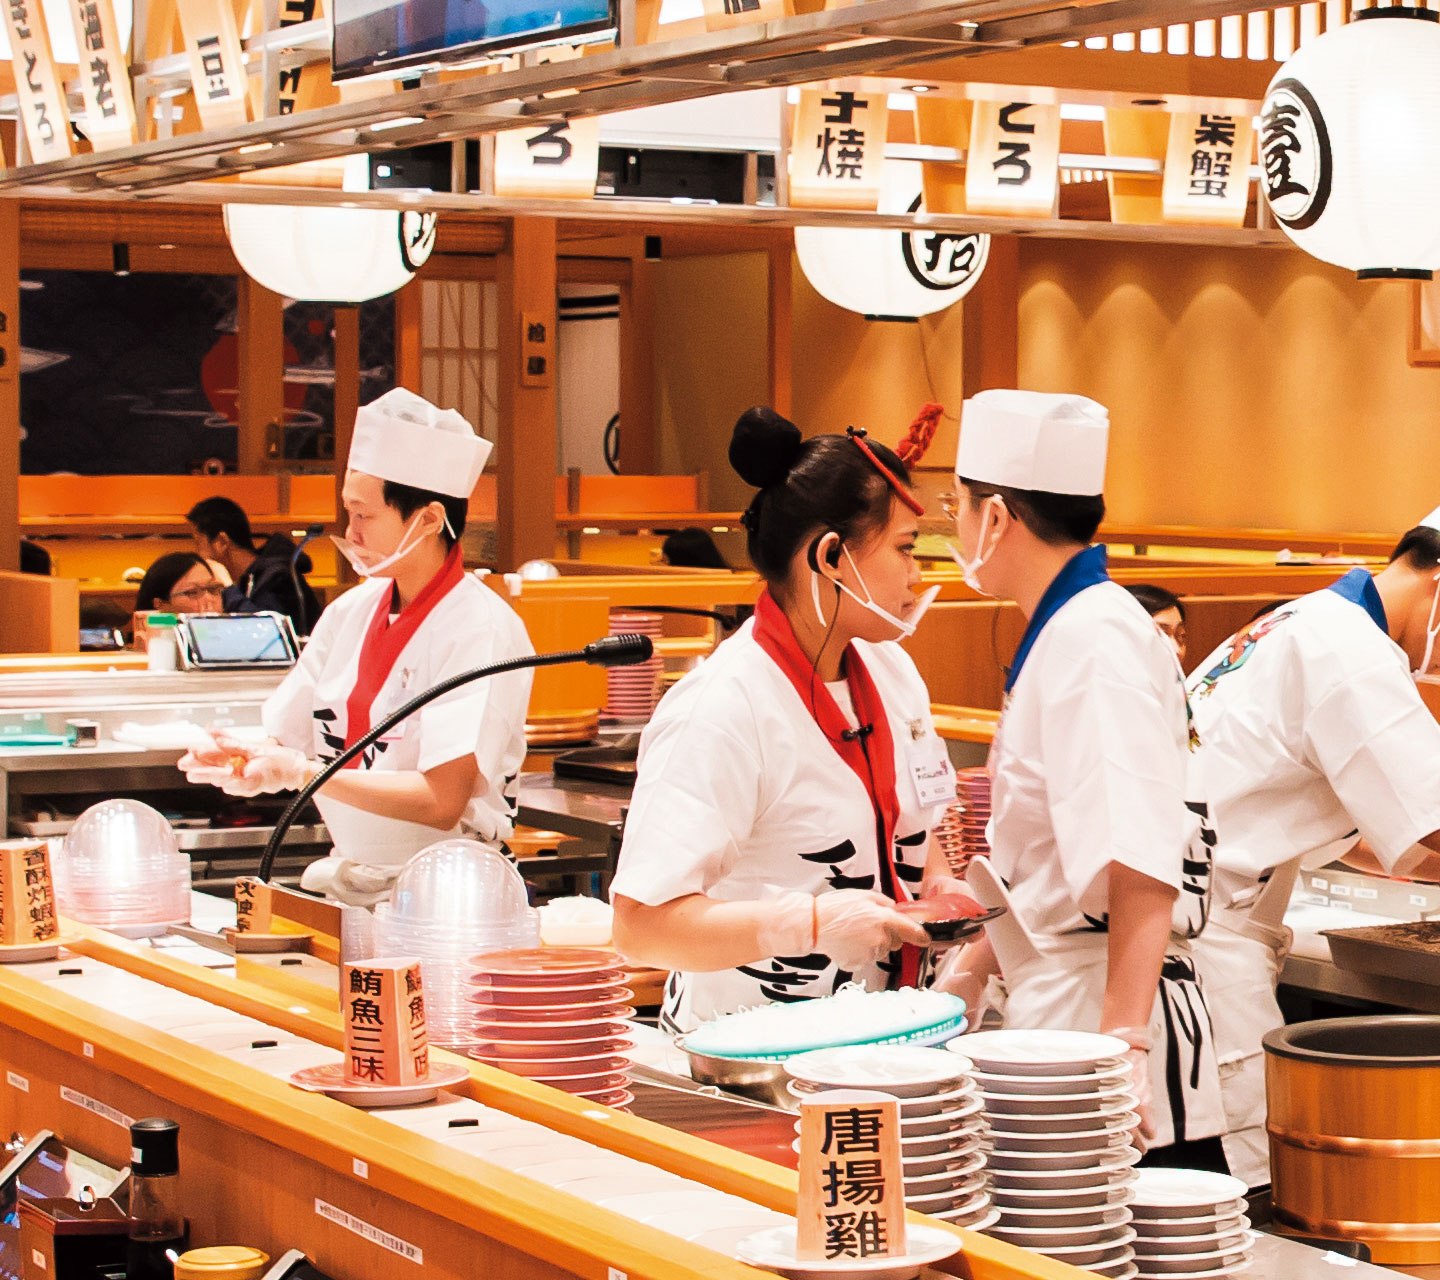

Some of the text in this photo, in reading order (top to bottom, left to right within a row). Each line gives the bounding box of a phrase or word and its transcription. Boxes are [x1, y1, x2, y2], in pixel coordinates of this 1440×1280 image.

[348, 968, 385, 1082] 鮪魚三味
[820, 1107, 889, 1260] 唐揚雞
